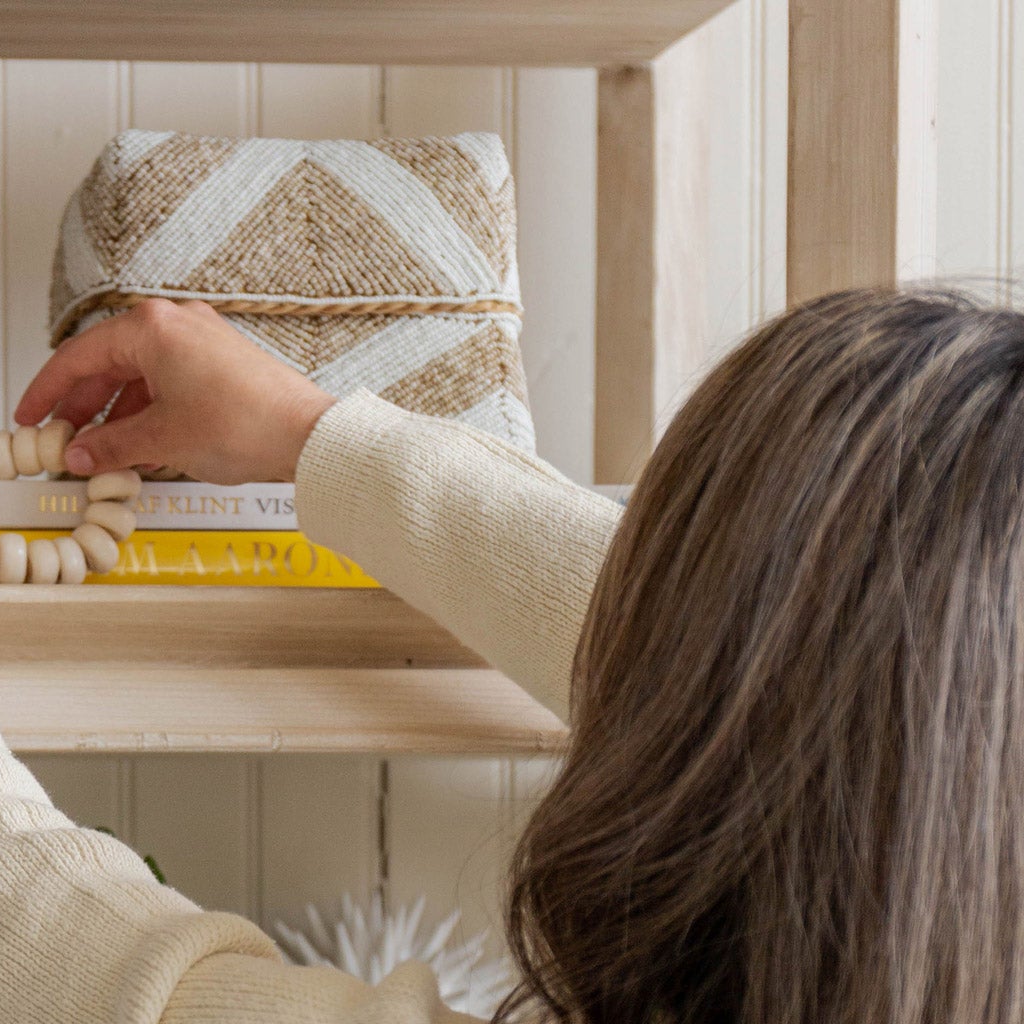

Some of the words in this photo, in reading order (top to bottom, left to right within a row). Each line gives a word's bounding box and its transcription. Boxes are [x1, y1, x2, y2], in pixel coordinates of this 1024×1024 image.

[166, 496, 245, 514] KLINT
[255, 497, 295, 515] VIS
[177, 541, 356, 578] AARON
